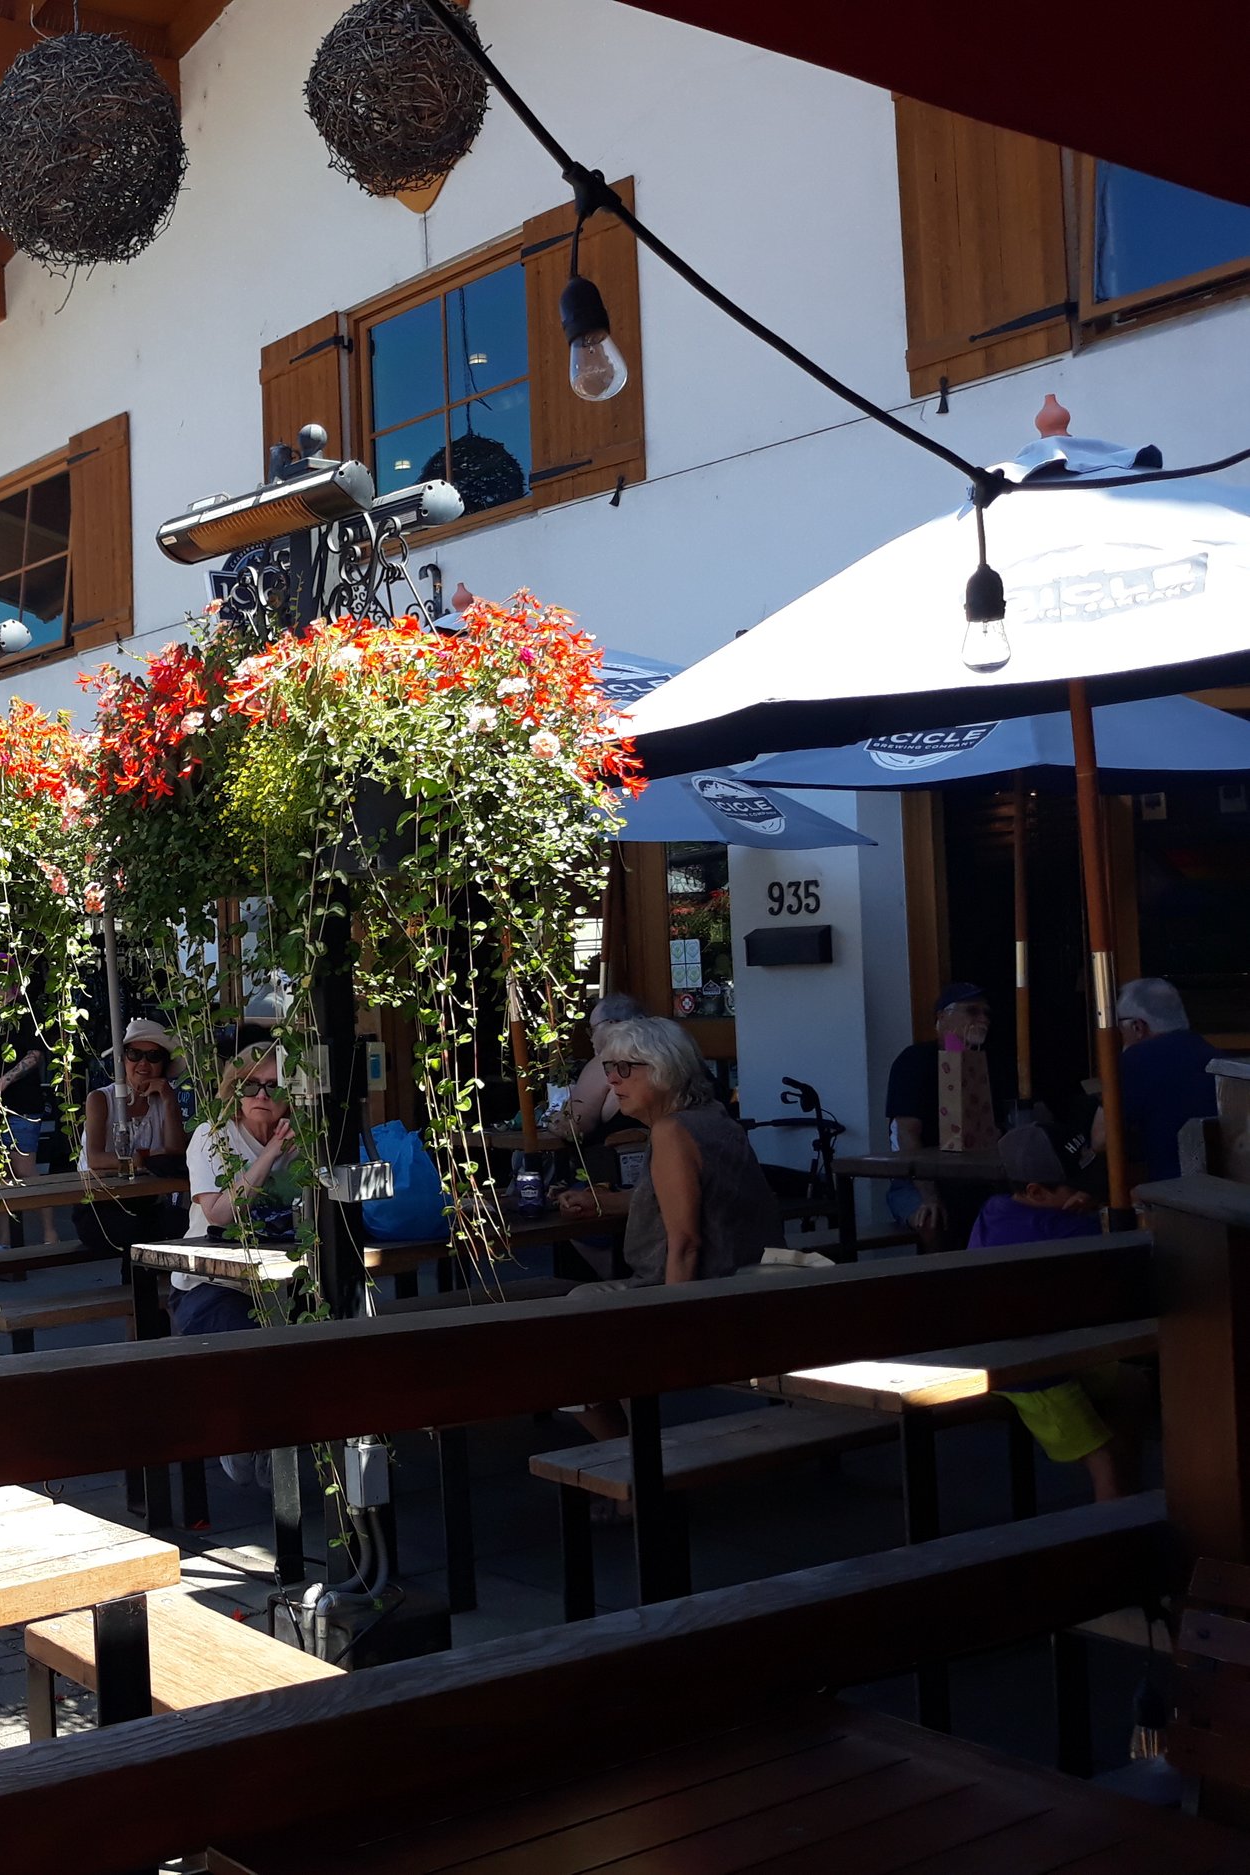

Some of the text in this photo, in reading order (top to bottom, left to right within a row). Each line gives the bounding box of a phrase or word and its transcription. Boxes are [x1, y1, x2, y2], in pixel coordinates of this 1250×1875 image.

[872, 740, 975, 750] BREWING COMPANY
[710, 800, 773, 812] ICICLE
[767, 879, 821, 917] 935
